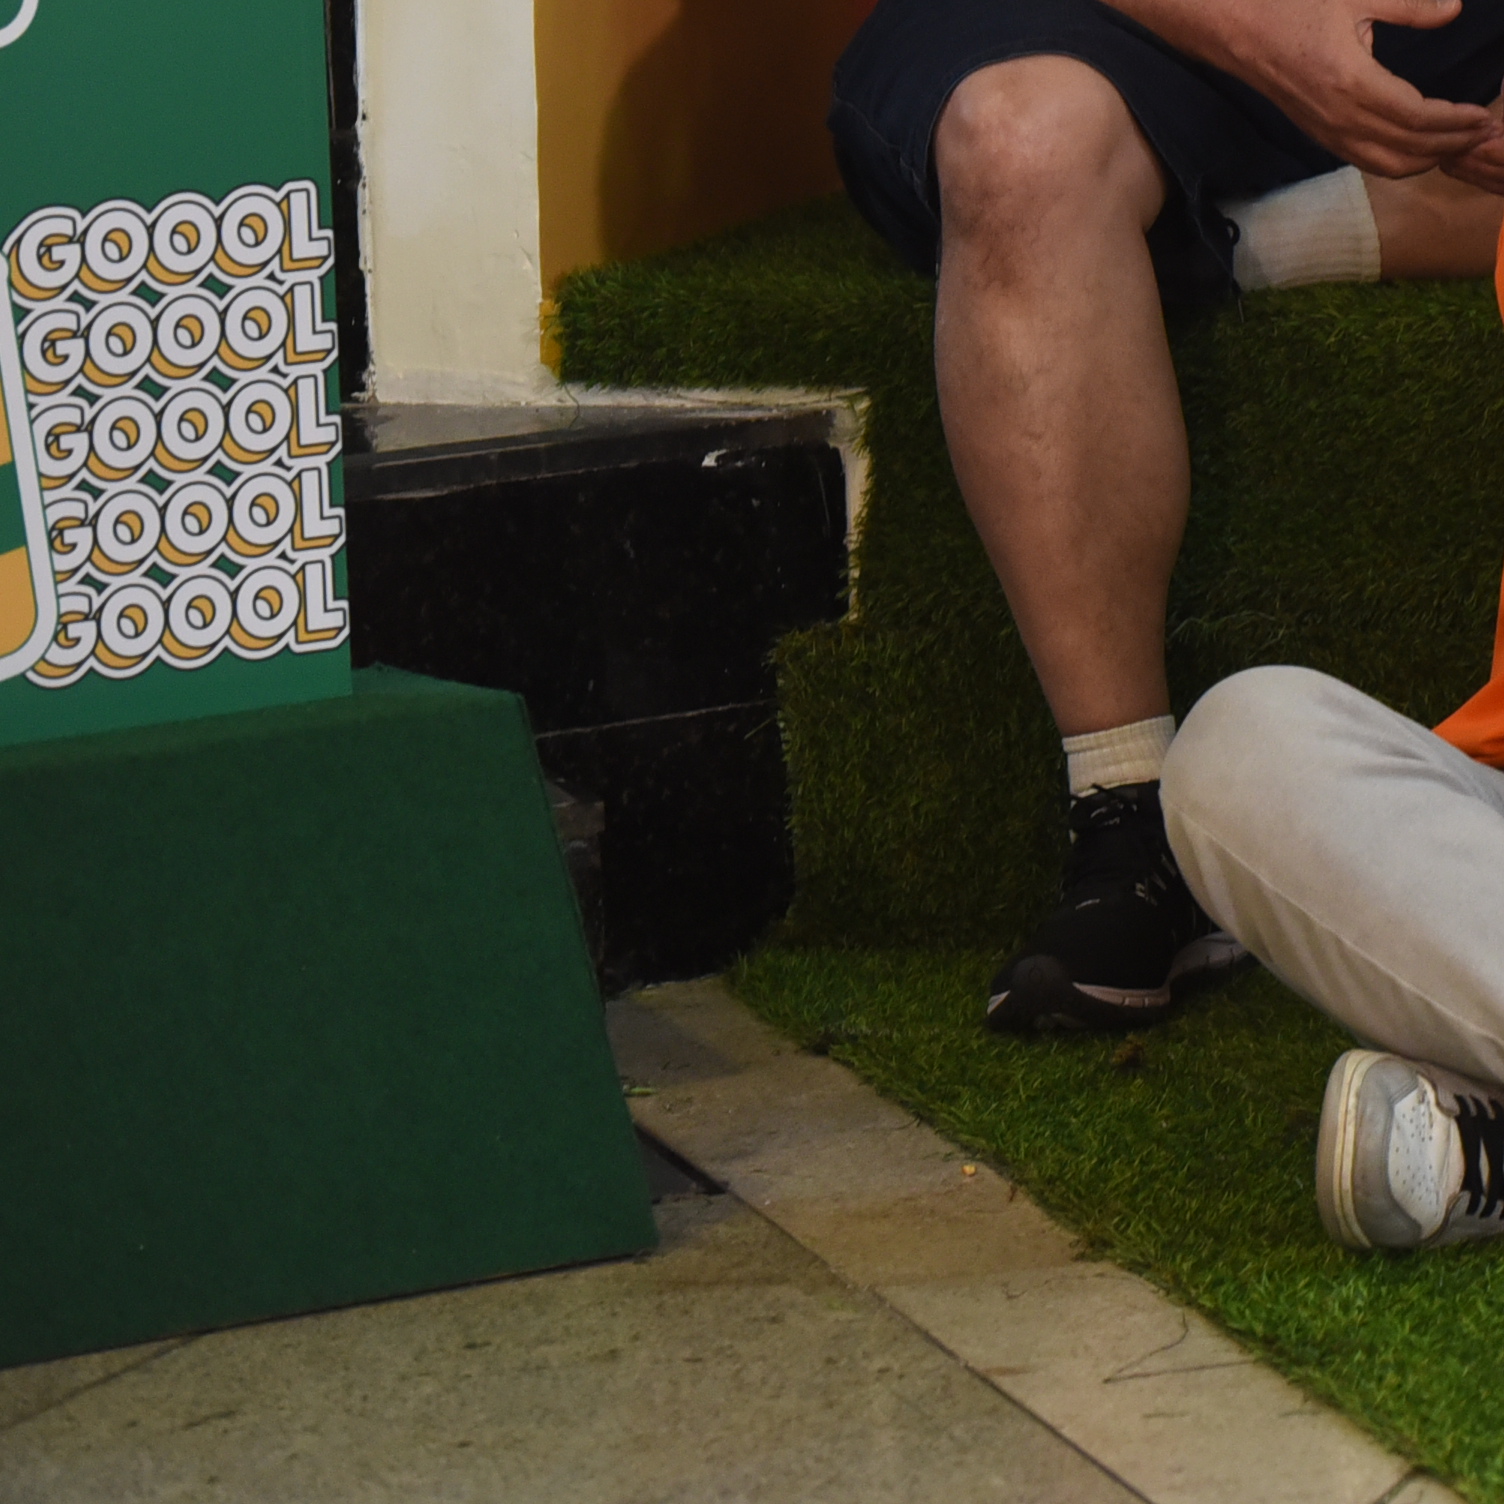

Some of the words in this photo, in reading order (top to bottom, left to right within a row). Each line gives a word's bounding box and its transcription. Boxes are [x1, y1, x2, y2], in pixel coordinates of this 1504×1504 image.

[12, 188, 333, 294] GOOOL
[21, 281, 337, 388] GOOOL
[30, 373, 341, 481] GOOOL
[45, 467, 345, 575] GOOOL
